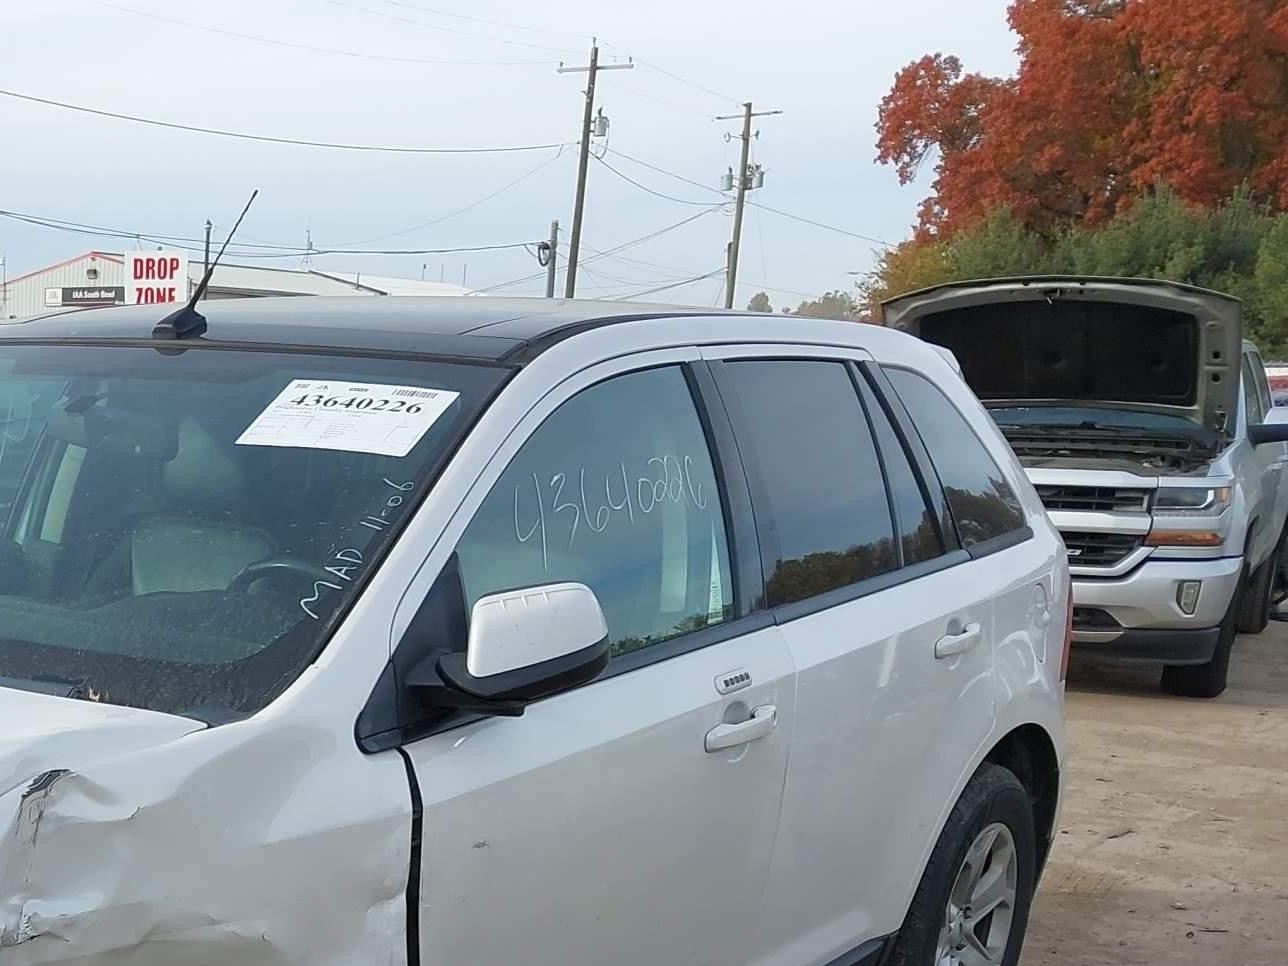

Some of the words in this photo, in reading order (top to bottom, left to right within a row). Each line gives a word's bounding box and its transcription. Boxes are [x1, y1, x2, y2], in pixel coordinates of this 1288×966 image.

[133, 257, 180, 280] DROP
[135, 286, 176, 304] ZONE
[290, 394, 425, 415] 43640226
[514, 455, 707, 574] 43640226
[300, 548, 363, 620] MAD
[359, 477, 415, 531] 11-06
